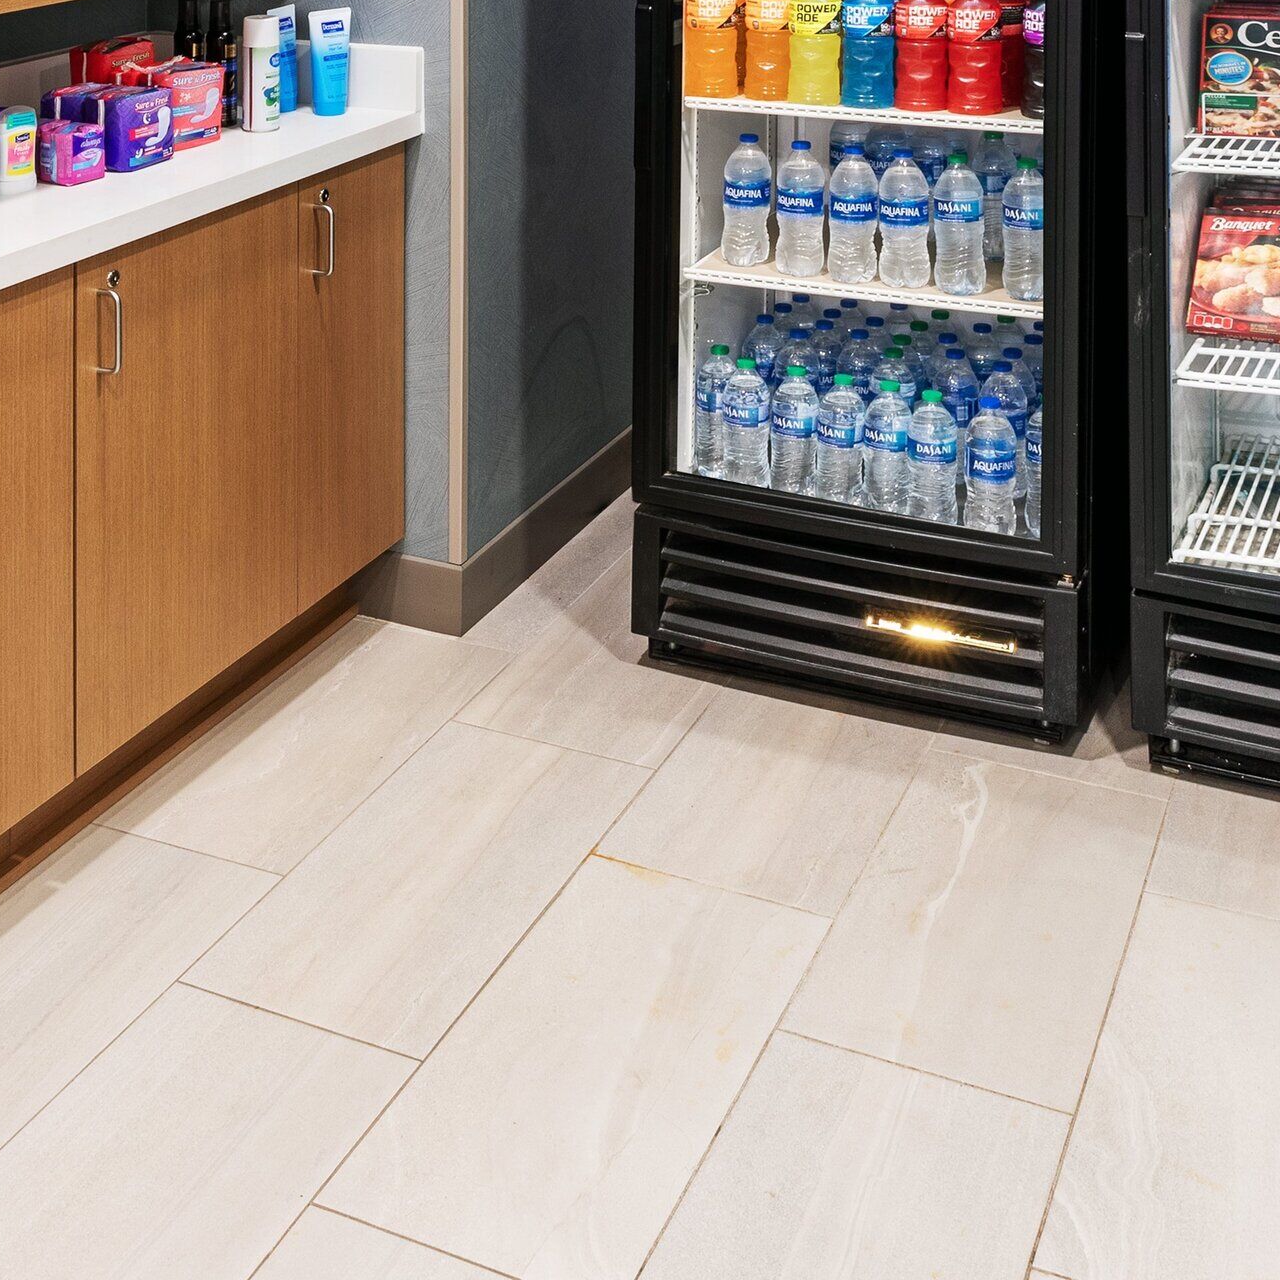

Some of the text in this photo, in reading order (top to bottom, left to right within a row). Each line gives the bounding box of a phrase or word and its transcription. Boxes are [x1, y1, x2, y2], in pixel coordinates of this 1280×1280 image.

[796, 4, 837, 13] POWER
[846, 6, 888, 17] POWER
[955, 9, 997, 20] POWER
[796, 13, 819, 22] ADE
[846, 15, 868, 25] ADE
[908, 15, 934, 26] ADE
[1024, 10, 1044, 22] POW
[955, 19, 980, 30] ADE
[132, 52, 150, 61] Fresh
[173, 71, 220, 86] Sure Fresh
[134, 102, 150, 111] Sure
[724, 188, 762, 199] AQUAFINA
[778, 194, 814, 208] AQUAFINA
[833, 202, 872, 213] AQUAFINA
[880, 204, 920, 217] AQUAFINA
[938, 201, 972, 214] DASANI
[1005, 208, 1040, 220] DASANI
[1210, 217, 1275, 231] Banquet
[724, 406, 749, 418] ASANI
[773, 416, 806, 430] DASANI
[820, 425, 846, 439] ASANI
[864, 428, 898, 443] DASANI
[916, 443, 951, 455] DASANI
[1027, 442, 1042, 455] DAS
[972, 459, 1014, 472] AQUAFINA
